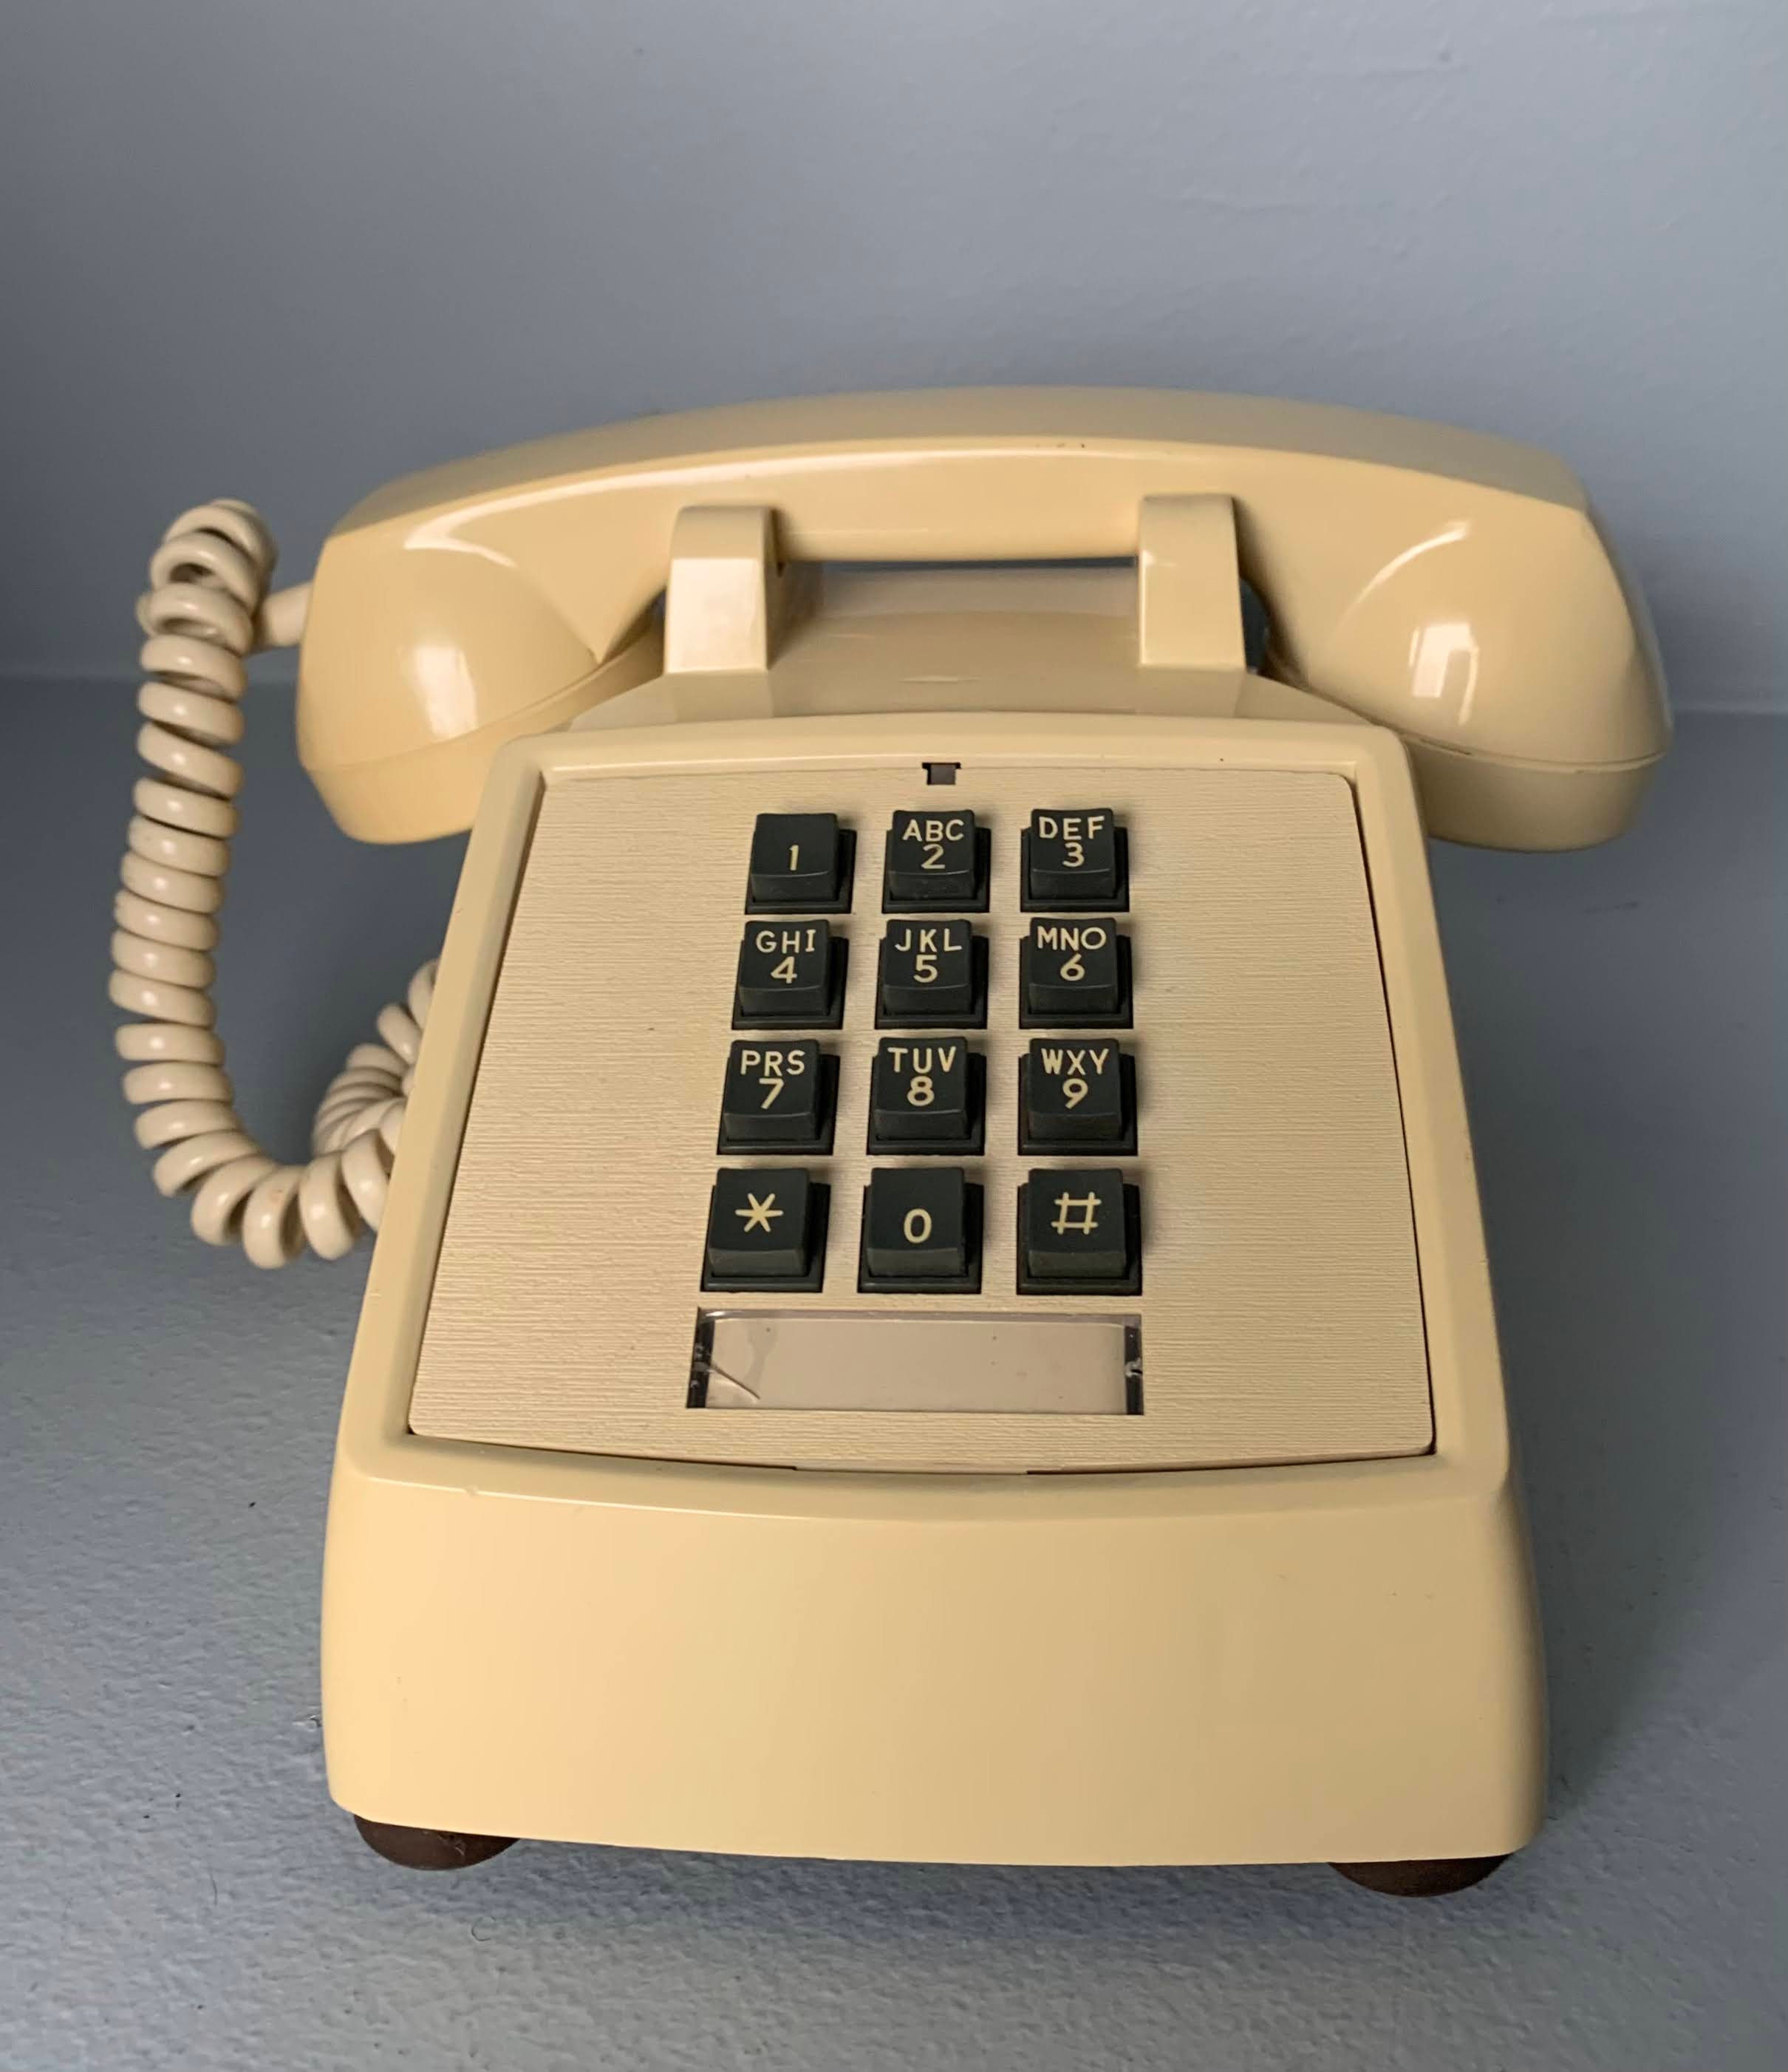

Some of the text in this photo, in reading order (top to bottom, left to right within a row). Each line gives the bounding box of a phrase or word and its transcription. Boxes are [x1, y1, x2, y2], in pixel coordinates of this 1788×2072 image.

[902, 818, 965, 842] ABC
[1038, 814, 1105, 841] DEF
[788, 844, 799, 872] 1
[921, 842, 946, 870] 2
[1062, 841, 1085, 868] 3
[755, 928, 817, 955] GHI
[894, 927, 963, 953] JKL
[1037, 924, 1108, 952] MNO
[770, 955, 799, 984] 4
[912, 953, 938, 984] 5
[1060, 952, 1086, 982] 6
[740, 1049, 806, 1077] PRS
[887, 1045, 958, 1074] TUV
[1040, 1047, 1110, 1076] WXY
[758, 1077, 785, 1110] 7
[906, 1074, 935, 1107] 8
[1062, 1077, 1089, 1110] 9
